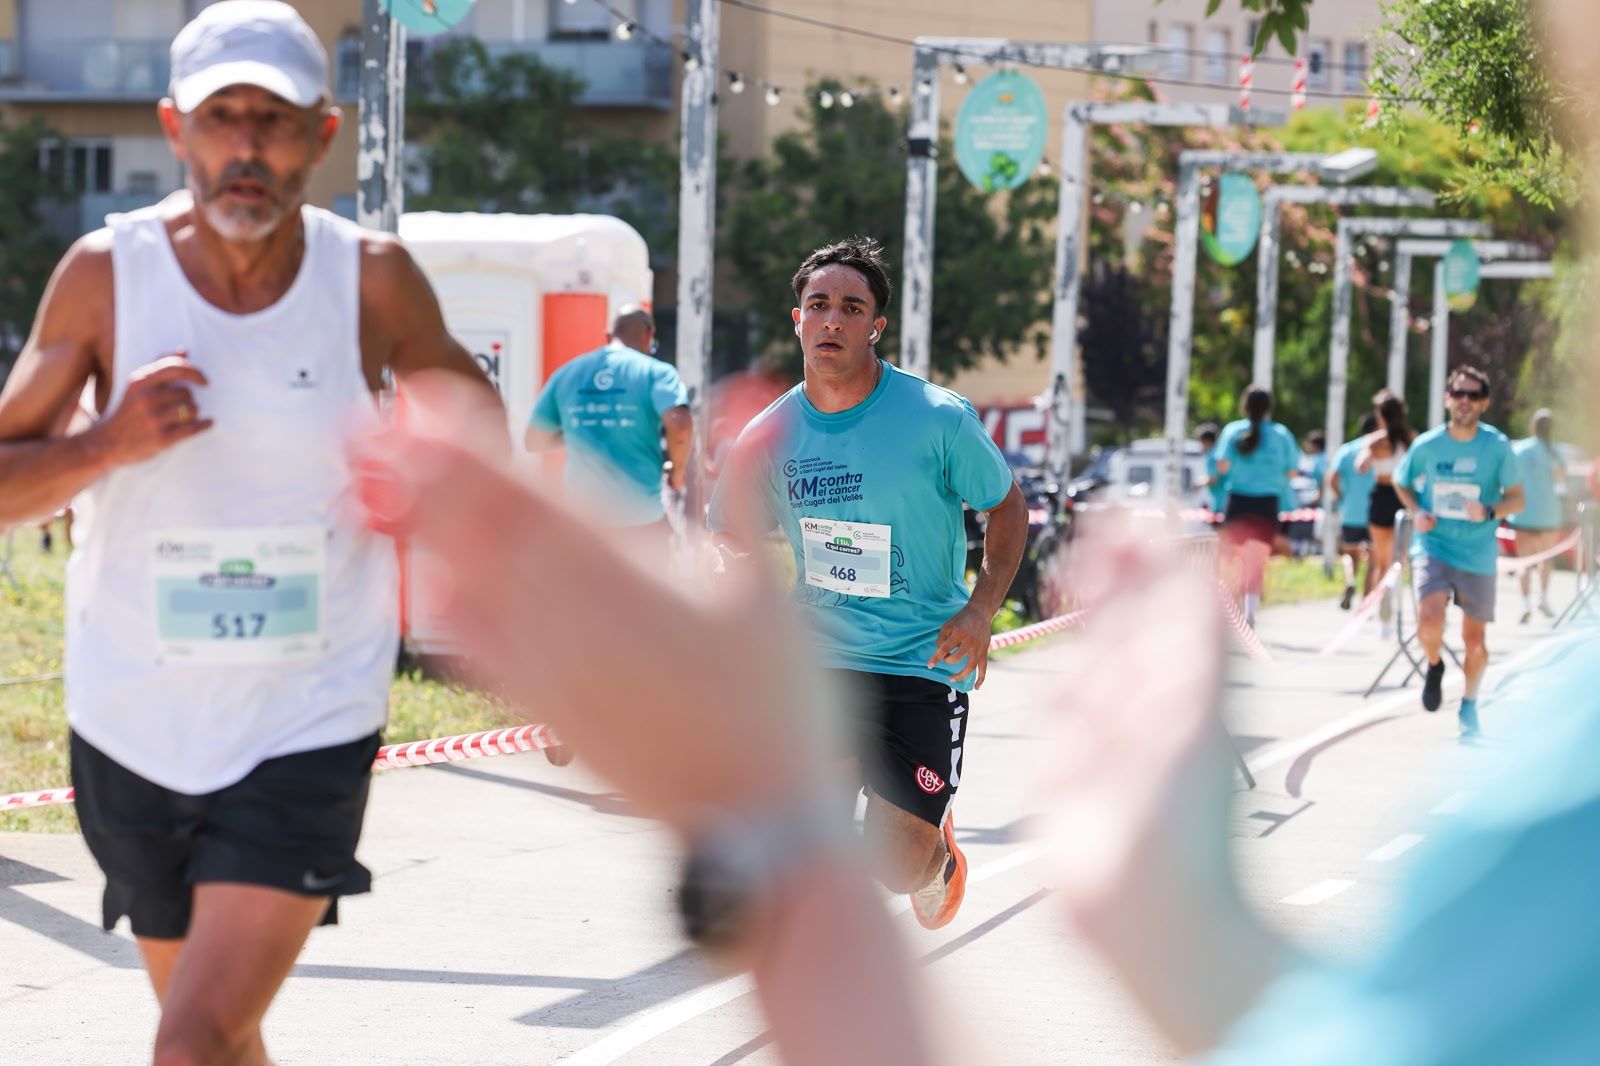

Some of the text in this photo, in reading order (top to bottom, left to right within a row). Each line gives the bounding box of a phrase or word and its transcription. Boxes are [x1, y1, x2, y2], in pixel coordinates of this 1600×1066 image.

[788, 472, 863, 501] KM contra
[818, 485, 861, 496] el càncer
[804, 498, 826, 507] Cugat
[827, 495, 841, 504] del
[842, 493, 864, 502] Vallès
[804, 522, 818, 530] KM
[839, 547, 860, 555] corres?
[830, 566, 856, 581] 468
[211, 613, 266, 638] 517
